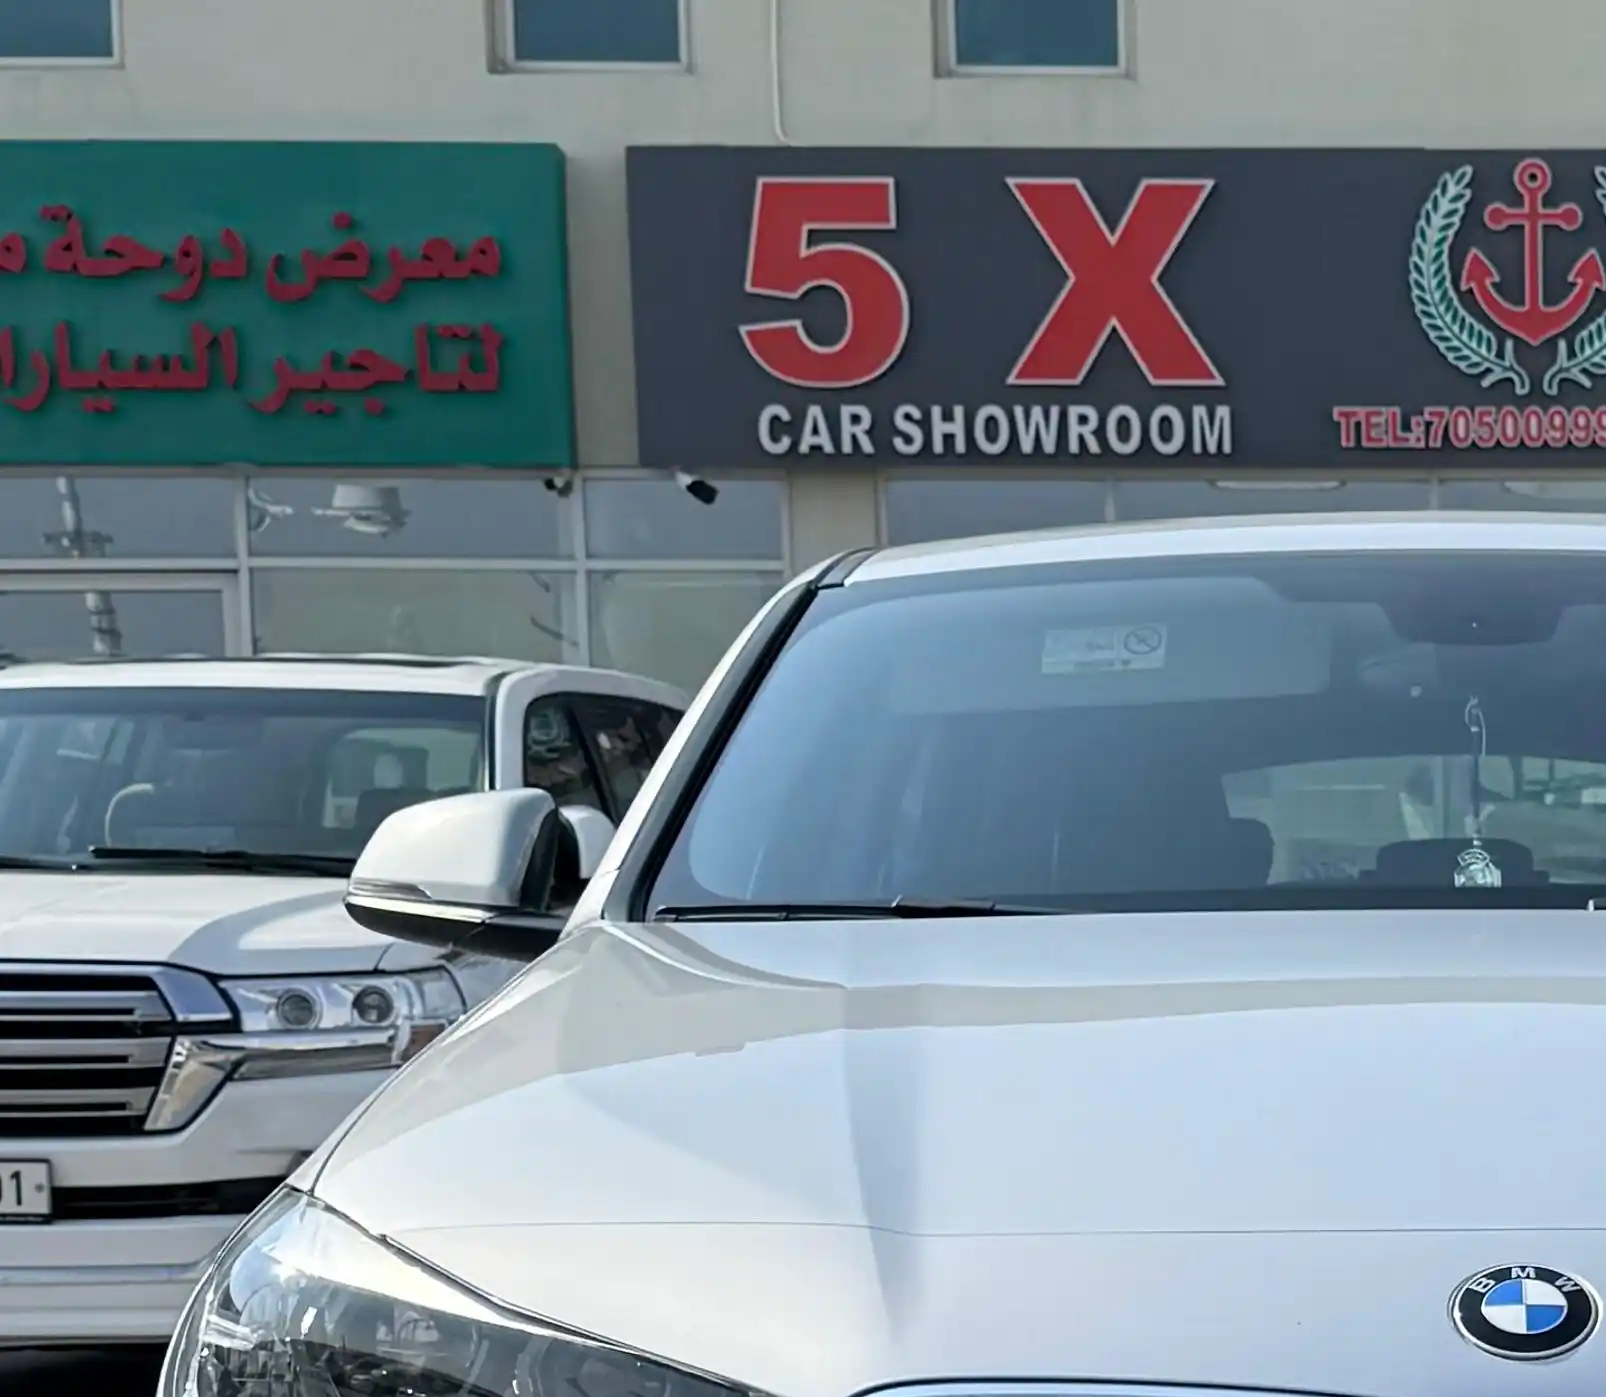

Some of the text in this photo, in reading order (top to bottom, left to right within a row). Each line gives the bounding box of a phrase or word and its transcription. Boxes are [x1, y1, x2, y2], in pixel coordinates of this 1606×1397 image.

[39, 203, 249, 303] دوحة
[263, 212, 501, 303] معرض
[739, 176, 1227, 388] 5 X
[249, 321, 506, 416] لتاجير
[757, 403, 1233, 456] CAR SHOWROOM
[1468, 1266, 1582, 1294] BMW
